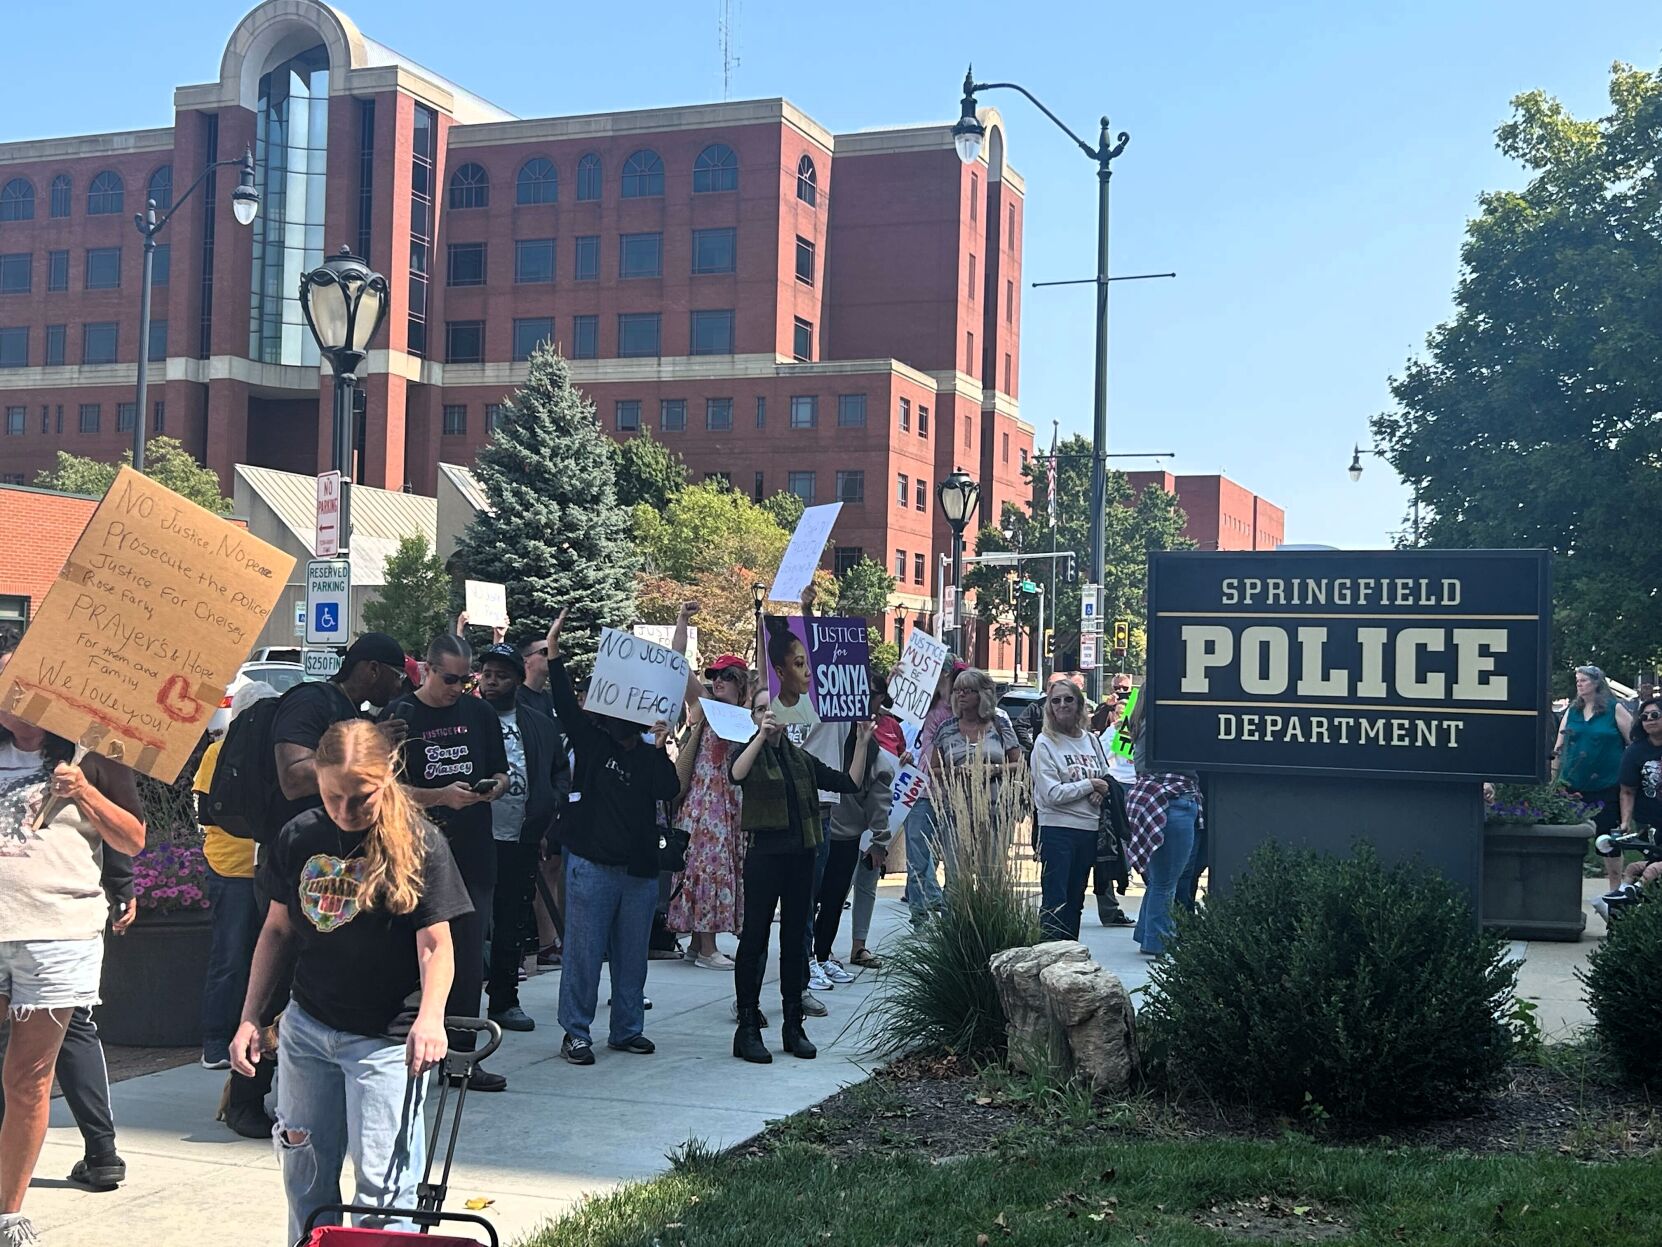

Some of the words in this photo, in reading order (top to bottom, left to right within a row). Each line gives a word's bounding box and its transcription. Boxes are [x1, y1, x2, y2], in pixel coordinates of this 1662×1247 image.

[116, 480, 154, 518] NO
[323, 480, 333, 496] NO
[89, 553, 152, 589] Justice
[103, 521, 193, 580] Prosecute
[198, 571, 228, 597] the
[309, 567, 348, 578] RESERVED
[82, 571, 115, 596] Rose
[312, 581, 345, 593] PARKING
[1221, 578, 1462, 606] SPRINGFIELD
[638, 626, 695, 640] JUSTE
[910, 632, 945, 660] JUSTICE
[103, 647, 129, 665] them
[133, 663, 160, 679] and
[182, 650, 215, 680] Hope
[307, 656, 328, 671] $250
[600, 631, 634, 661] NO
[640, 644, 688, 677] JUSTICE
[833, 645, 848, 663] for
[903, 646, 940, 677] MUST
[1180, 625, 1508, 700] POLICE
[38, 656, 73, 690] We
[80, 678, 120, 711] love
[817, 664, 869, 696] SONYA
[910, 669, 922, 682] BE
[590, 678, 619, 705] NO
[626, 687, 678, 722] PEACE
[818, 695, 870, 718] MASSEY
[891, 674, 932, 719] SERVED
[1217, 713, 1464, 748] DEPARTMENT
[425, 745, 469, 762] Sonya
[424, 762, 473, 780] Massey
